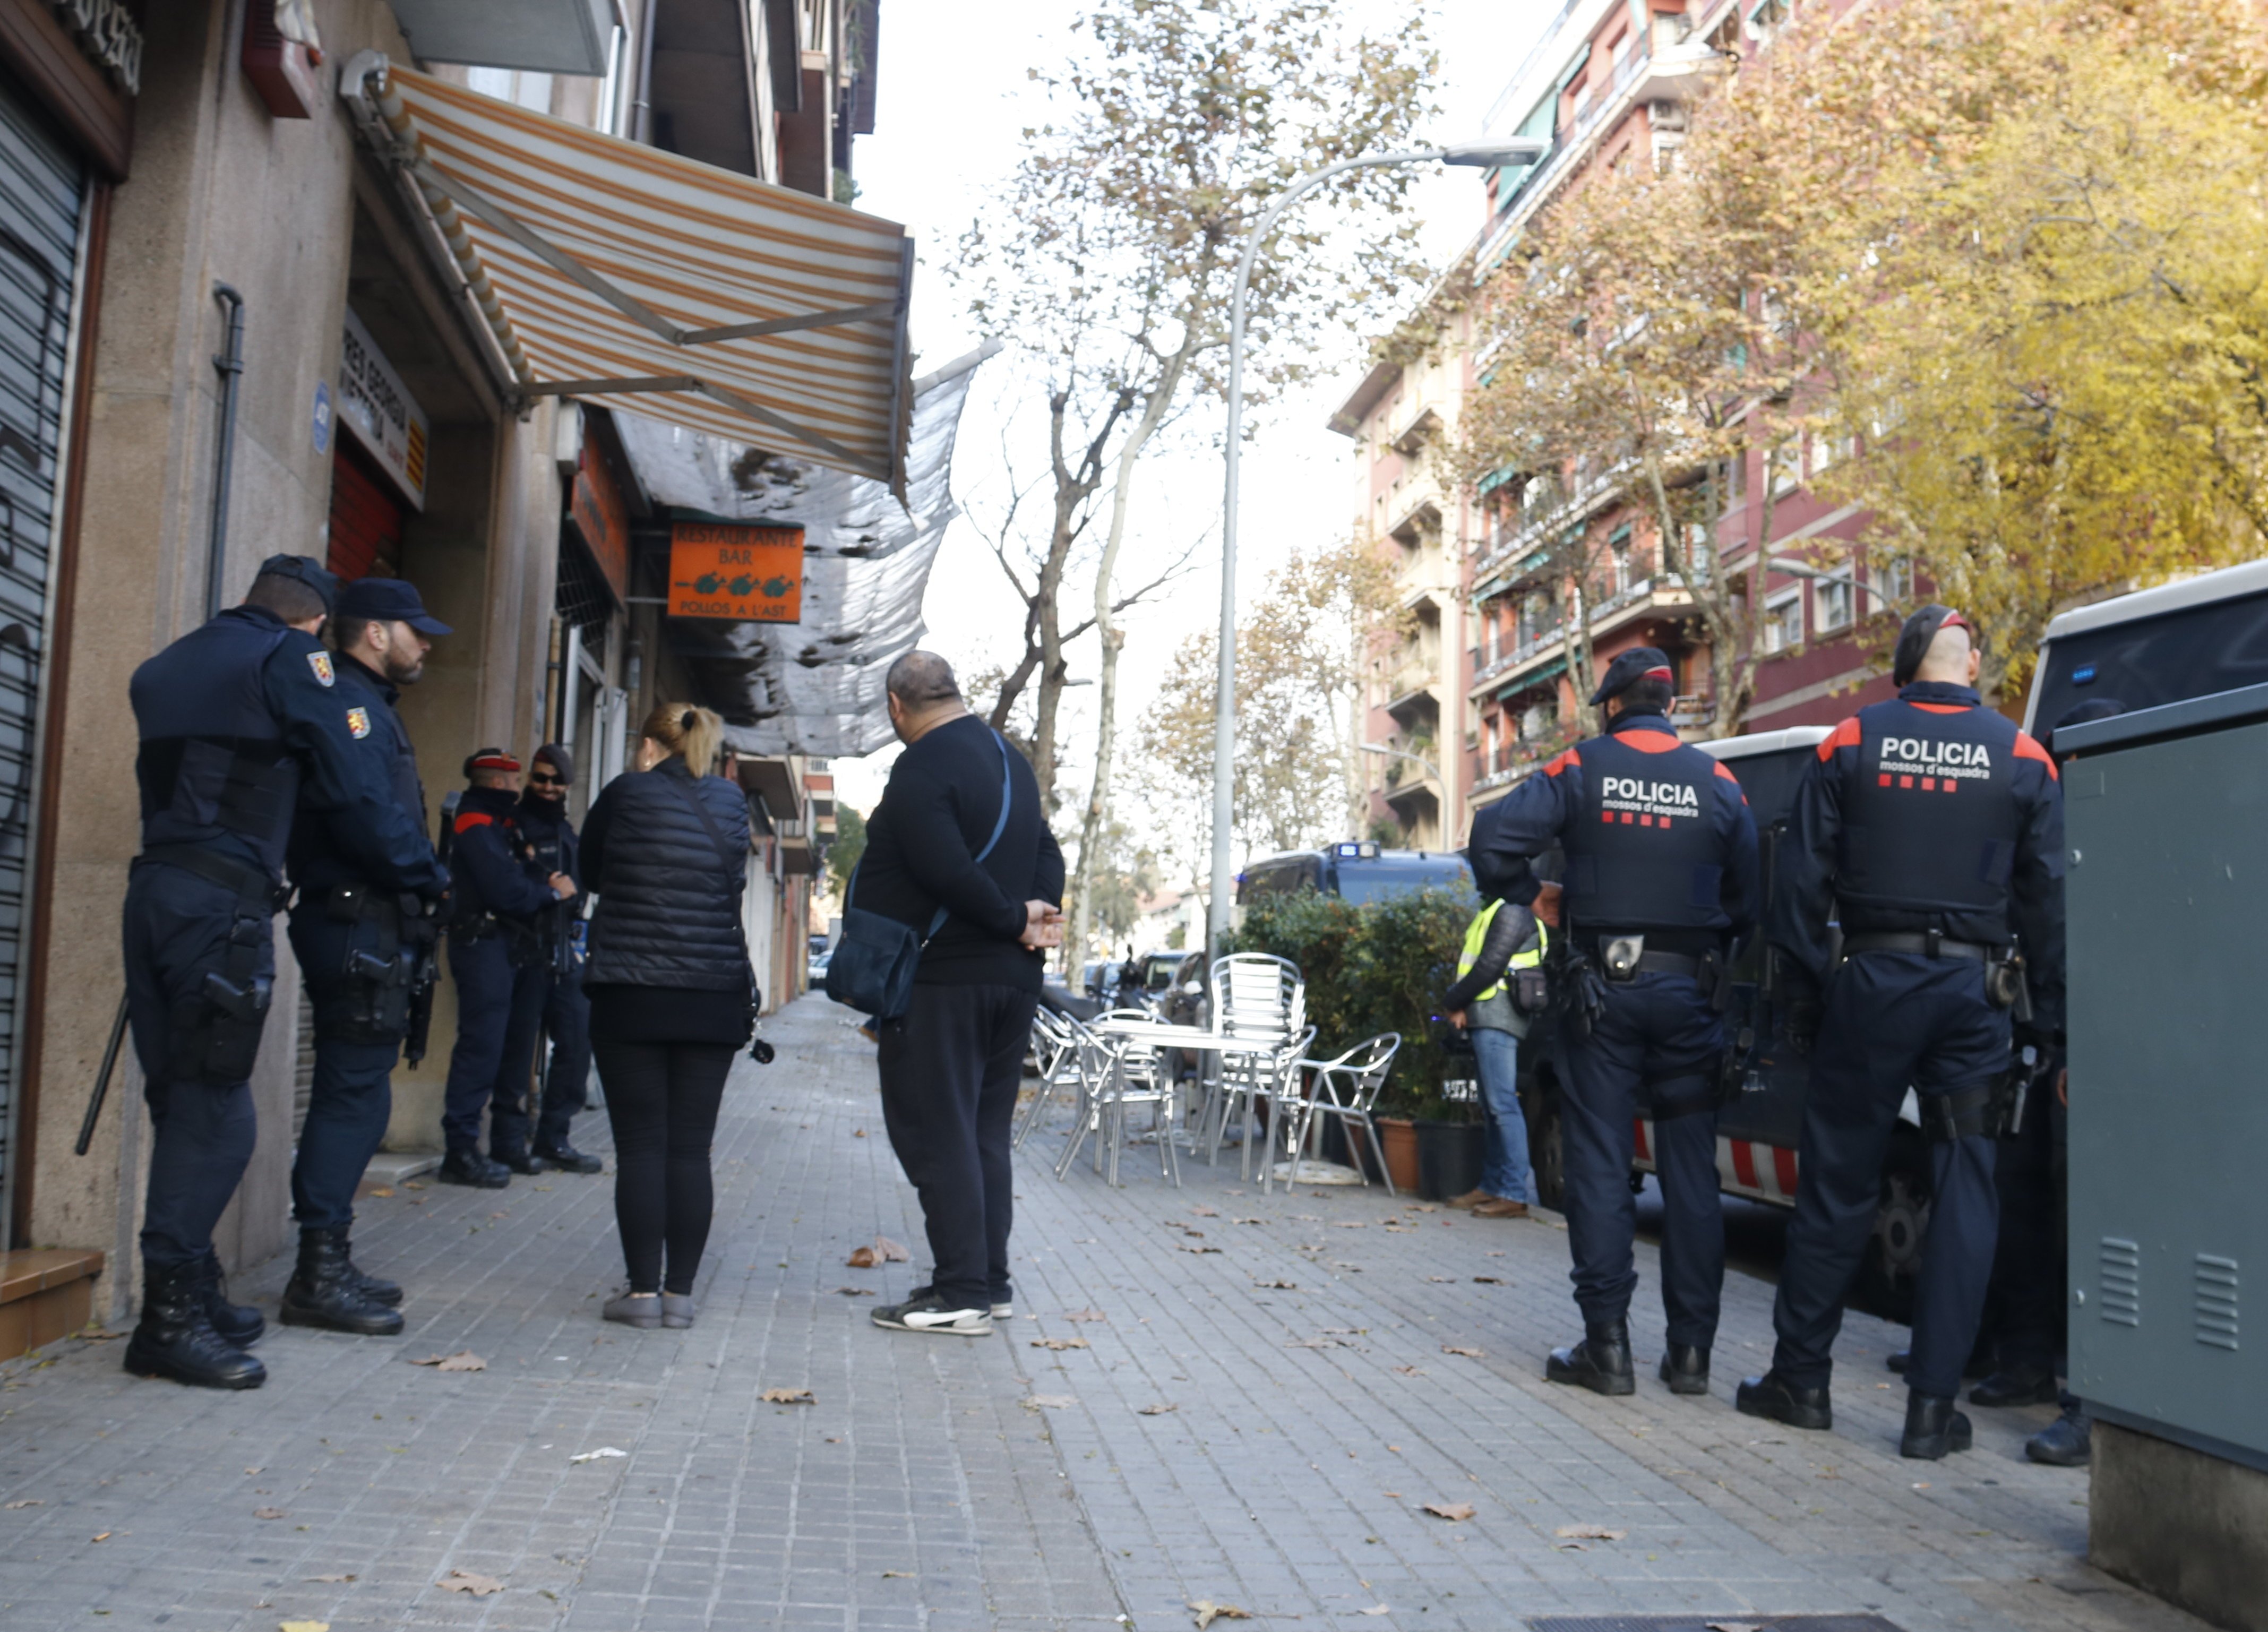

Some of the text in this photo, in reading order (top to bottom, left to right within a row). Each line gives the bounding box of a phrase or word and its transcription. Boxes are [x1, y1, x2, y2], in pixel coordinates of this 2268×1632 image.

[677, 526, 797, 547] RESTAURANTE
[719, 548, 752, 565] BAR
[681, 601, 786, 616] POLLOS A L'AST
[1881, 737, 1990, 767] POLICIA
[1880, 761, 1925, 774] mossos
[1602, 777, 1698, 806] POLICIA
[1602, 800, 1643, 812] mossos
